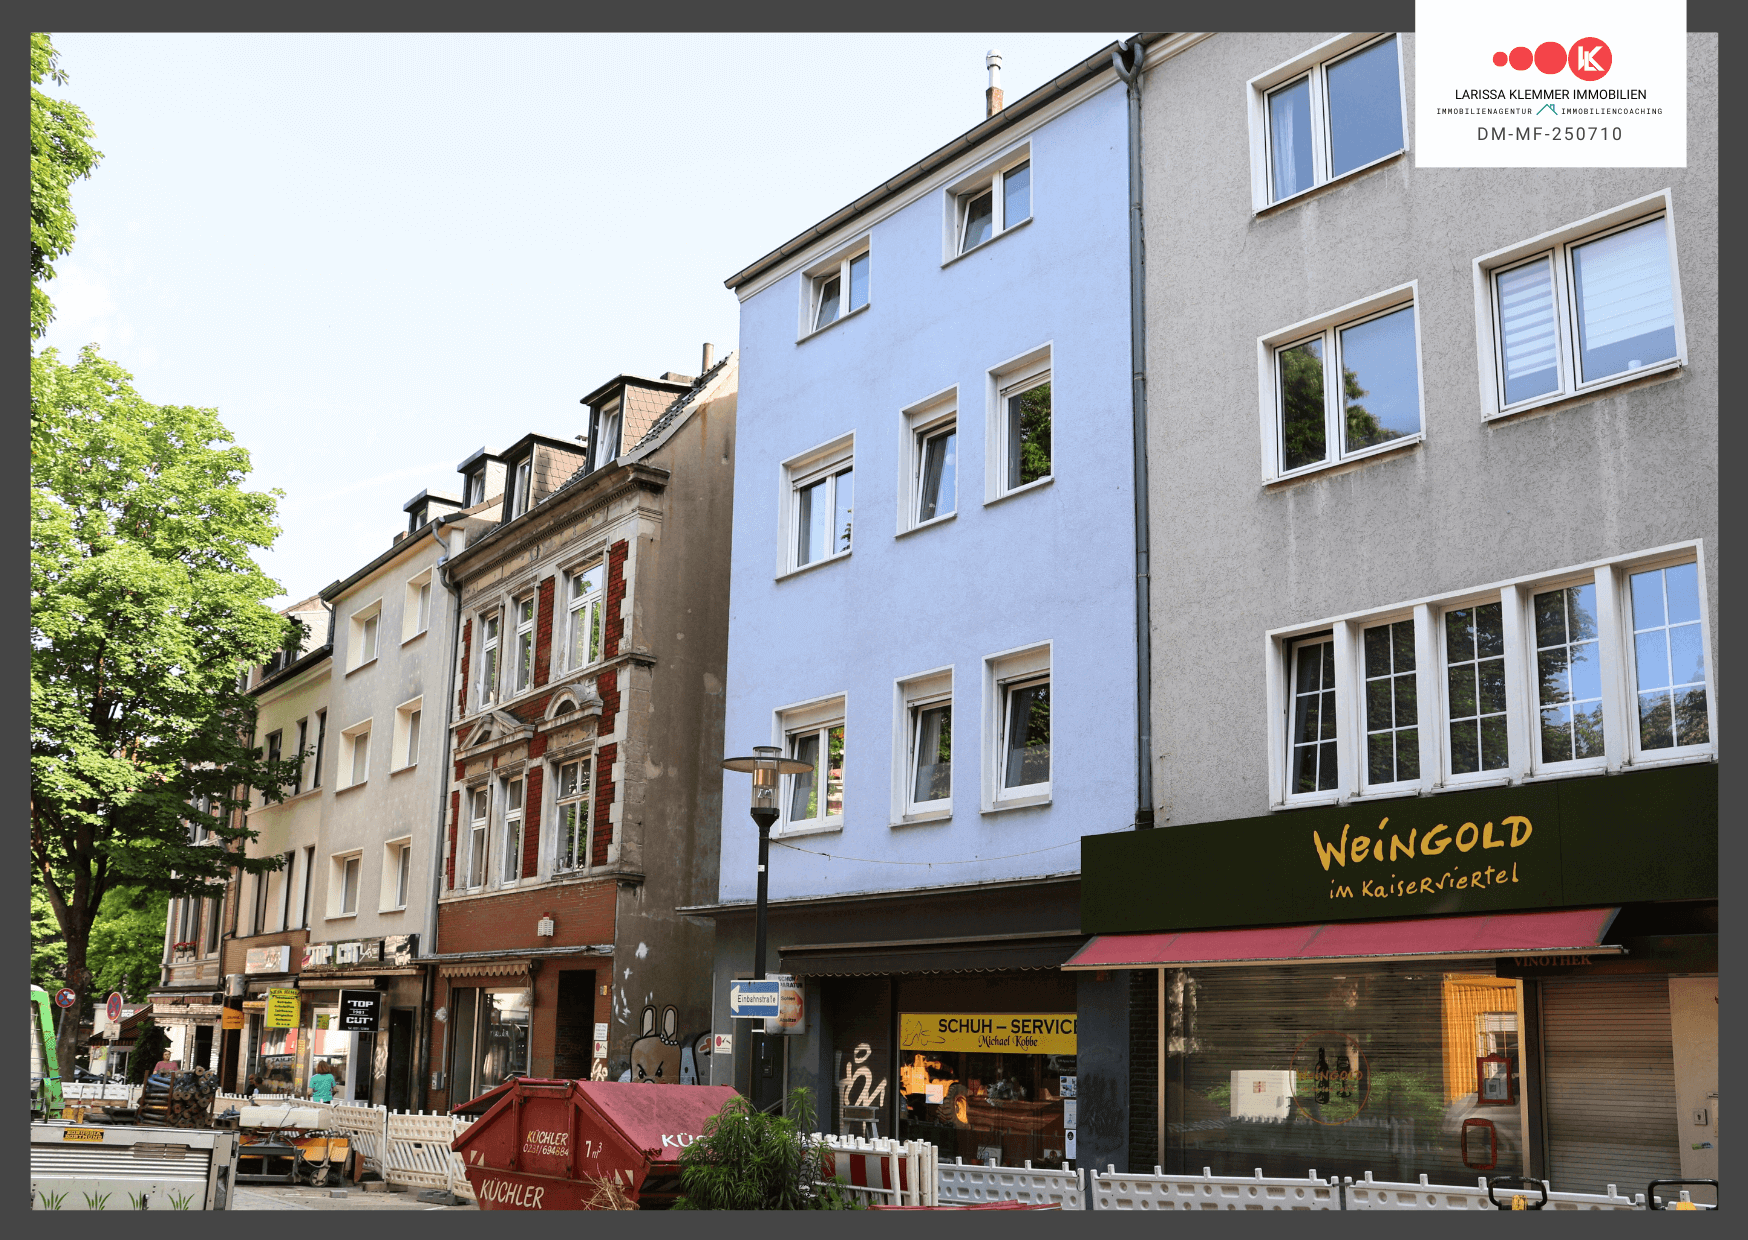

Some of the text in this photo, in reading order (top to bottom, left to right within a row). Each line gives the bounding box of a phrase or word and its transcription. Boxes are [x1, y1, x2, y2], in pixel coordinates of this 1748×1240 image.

[1514, 954, 1593, 967] VINOTHEK
[737, 994, 776, 1004] Einbahnstraße
[938, 1018, 993, 1034] SCHUH
[978, 1035, 1038, 1052] Michael Kobbe
[526, 1129, 569, 1146] KÜCHLER
[480, 1177, 545, 1210] KÜCHLER
